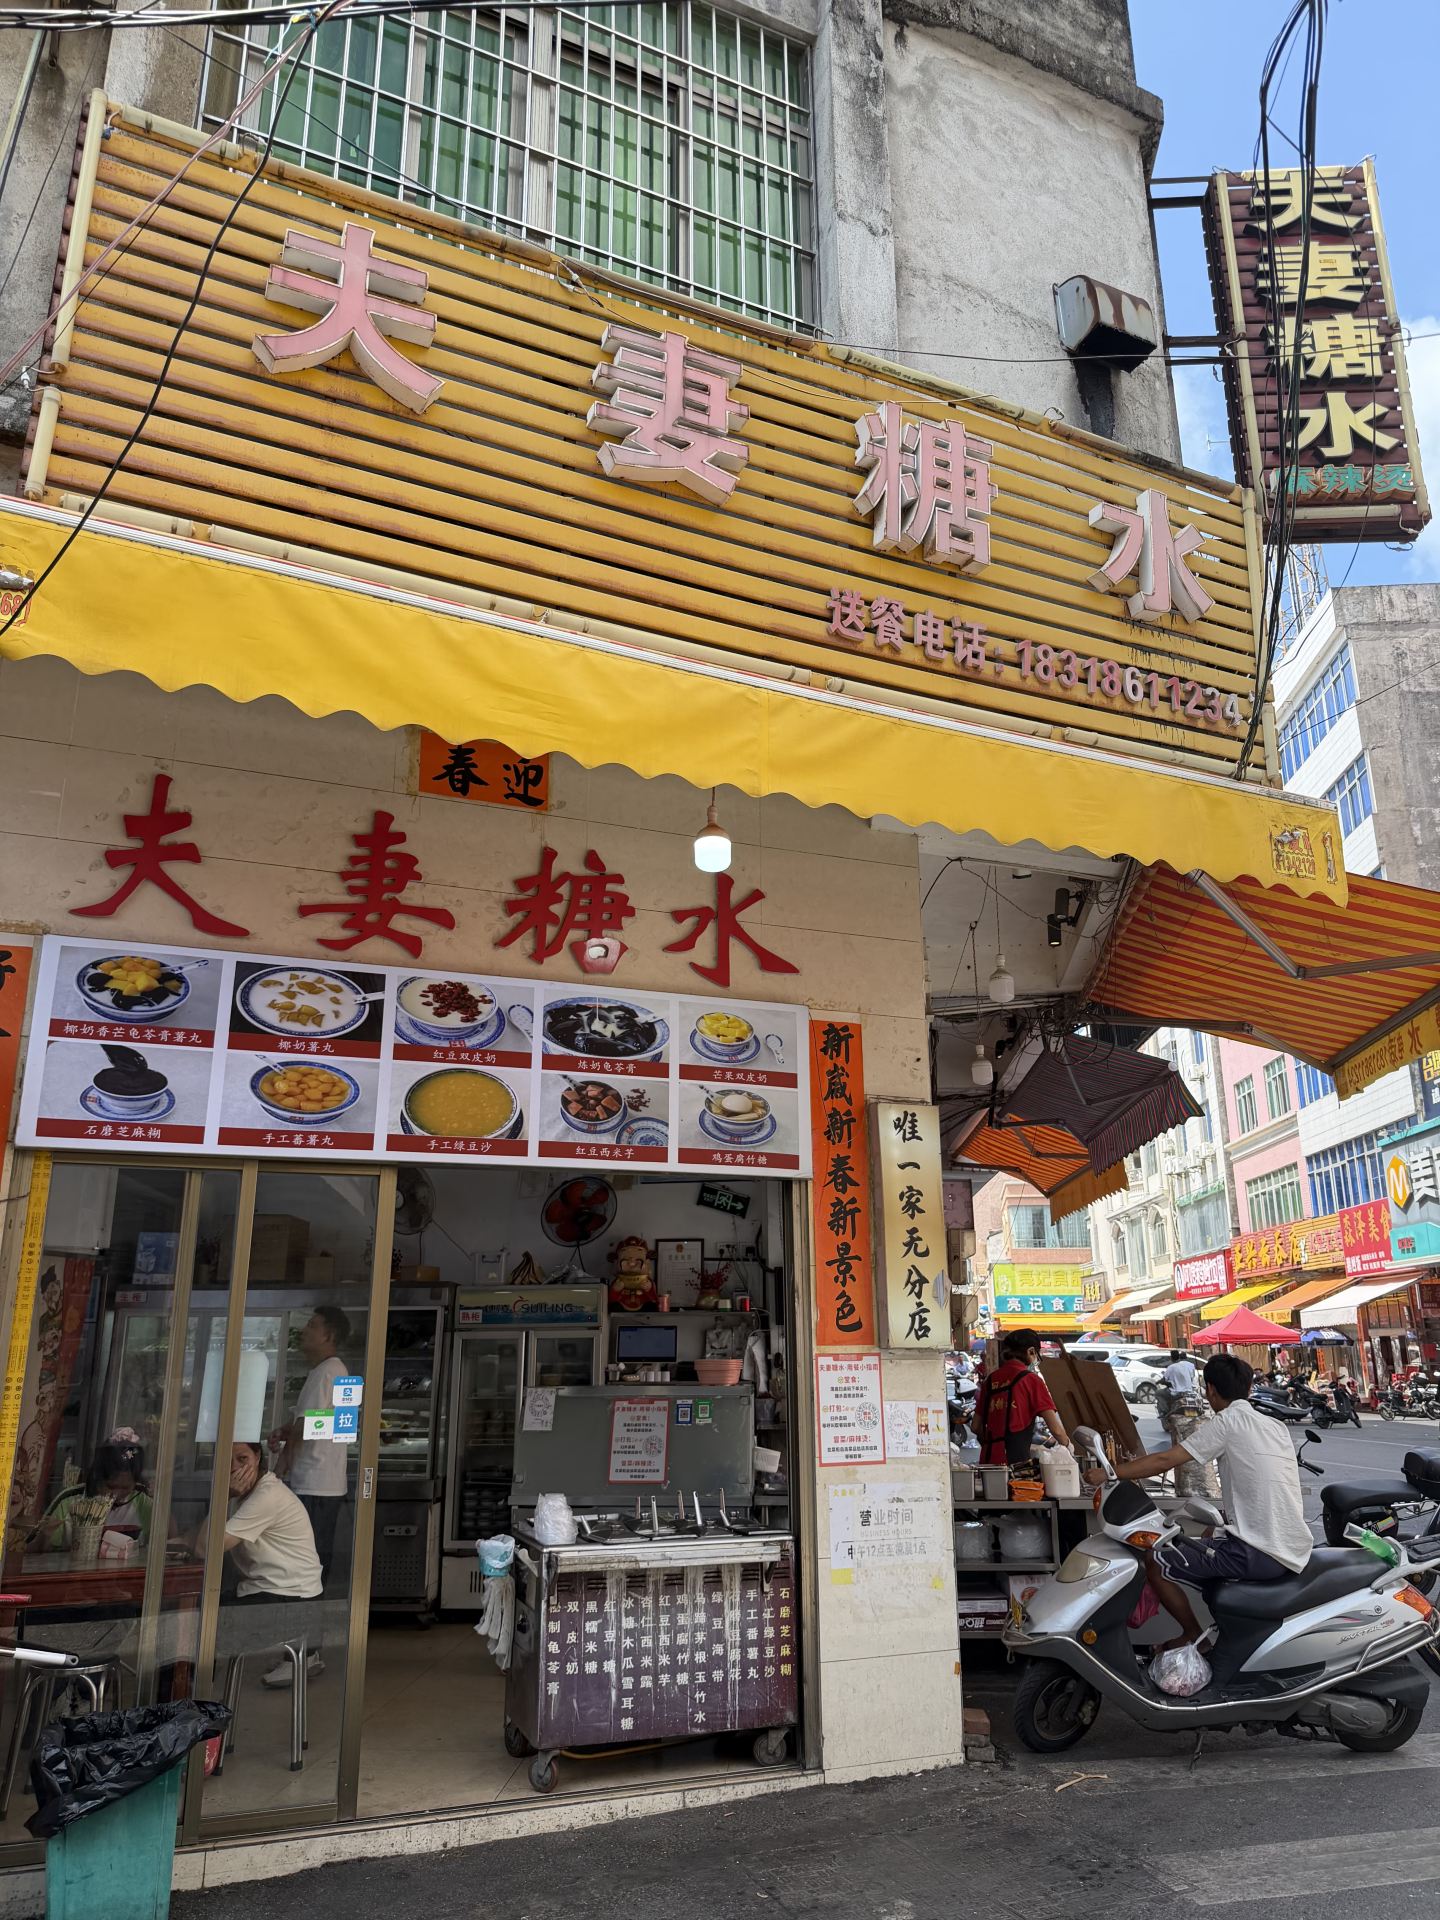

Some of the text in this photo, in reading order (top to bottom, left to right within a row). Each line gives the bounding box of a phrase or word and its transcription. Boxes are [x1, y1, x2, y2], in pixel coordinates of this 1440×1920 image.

[1245, 170, 1400, 460] 夫妻糖水
[252, 222, 1215, 624] 夫妻糖水
[1270, 463, 1417, 500] 麻辣烫
[68, 774, 801, 988] 夫妻糖水
[64, 1022, 202, 1044] 椰奶香芒龟苓膏薯丸
[277, 1039, 335, 1053] 椰奶薯丸
[432, 1050, 496, 1064] 红豆双皮奶
[577, 1060, 636, 1074] 炼奶龟苓膏
[712, 1070, 767, 1083] 芒果双皮奶
[84, 1124, 161, 1139] 石磨芝麻糊
[427, 1140, 492, 1153] 手工绿豆沙
[575, 1145, 635, 1159] 红豆西米芋
[712, 1153, 767, 1165] 鸡蛋腐竹糖
[892, 1110, 931, 1342] 唯一家无分店
[1007, 1297, 1083, 1312] 亮记食品
[339, 1413, 353, 1428] 拉
[859, 1508, 914, 1527] 营业时间
[565, 1601, 579, 1675] 双皮奶
[602, 1600, 616, 1673] 红豆糖
[620, 1598, 634, 1730] 冰糖木瓜雪耳糖
[640, 1595, 653, 1688] 杏仁西米露
[658, 1594, 671, 1686] 红豆西米芋
[676, 1593, 689, 1685] 鸡蛋腐竹糖
[694, 1592, 707, 1723] 马蹄茅根玉竹水
[711, 1591, 724, 1682] 绿豆海带
[746, 1589, 759, 1679] 手工番薯丸
[779, 1587, 791, 1676] 石磨芝麻糊
